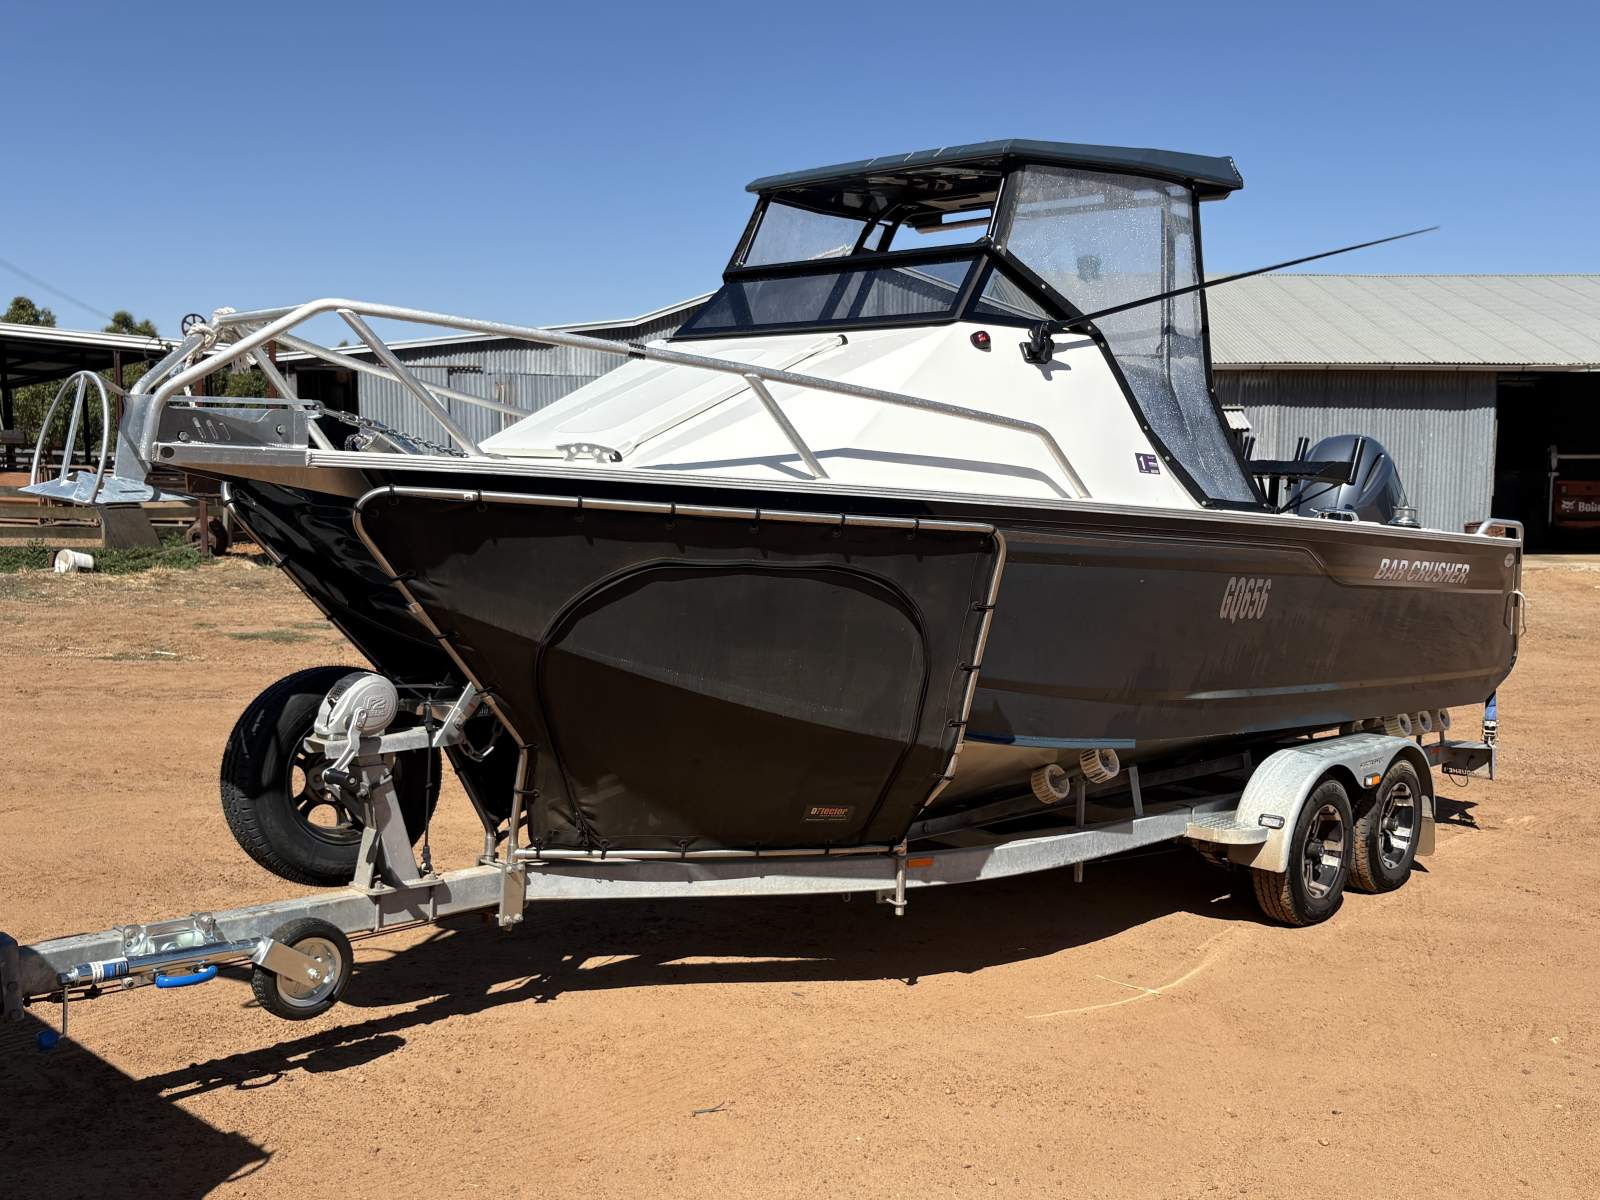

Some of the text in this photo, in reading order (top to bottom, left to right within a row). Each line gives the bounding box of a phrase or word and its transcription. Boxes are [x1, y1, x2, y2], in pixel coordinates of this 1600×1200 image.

[1374, 558, 1470, 584] BAR CRUSHER
[1220, 576, 1272, 624] GQ656
